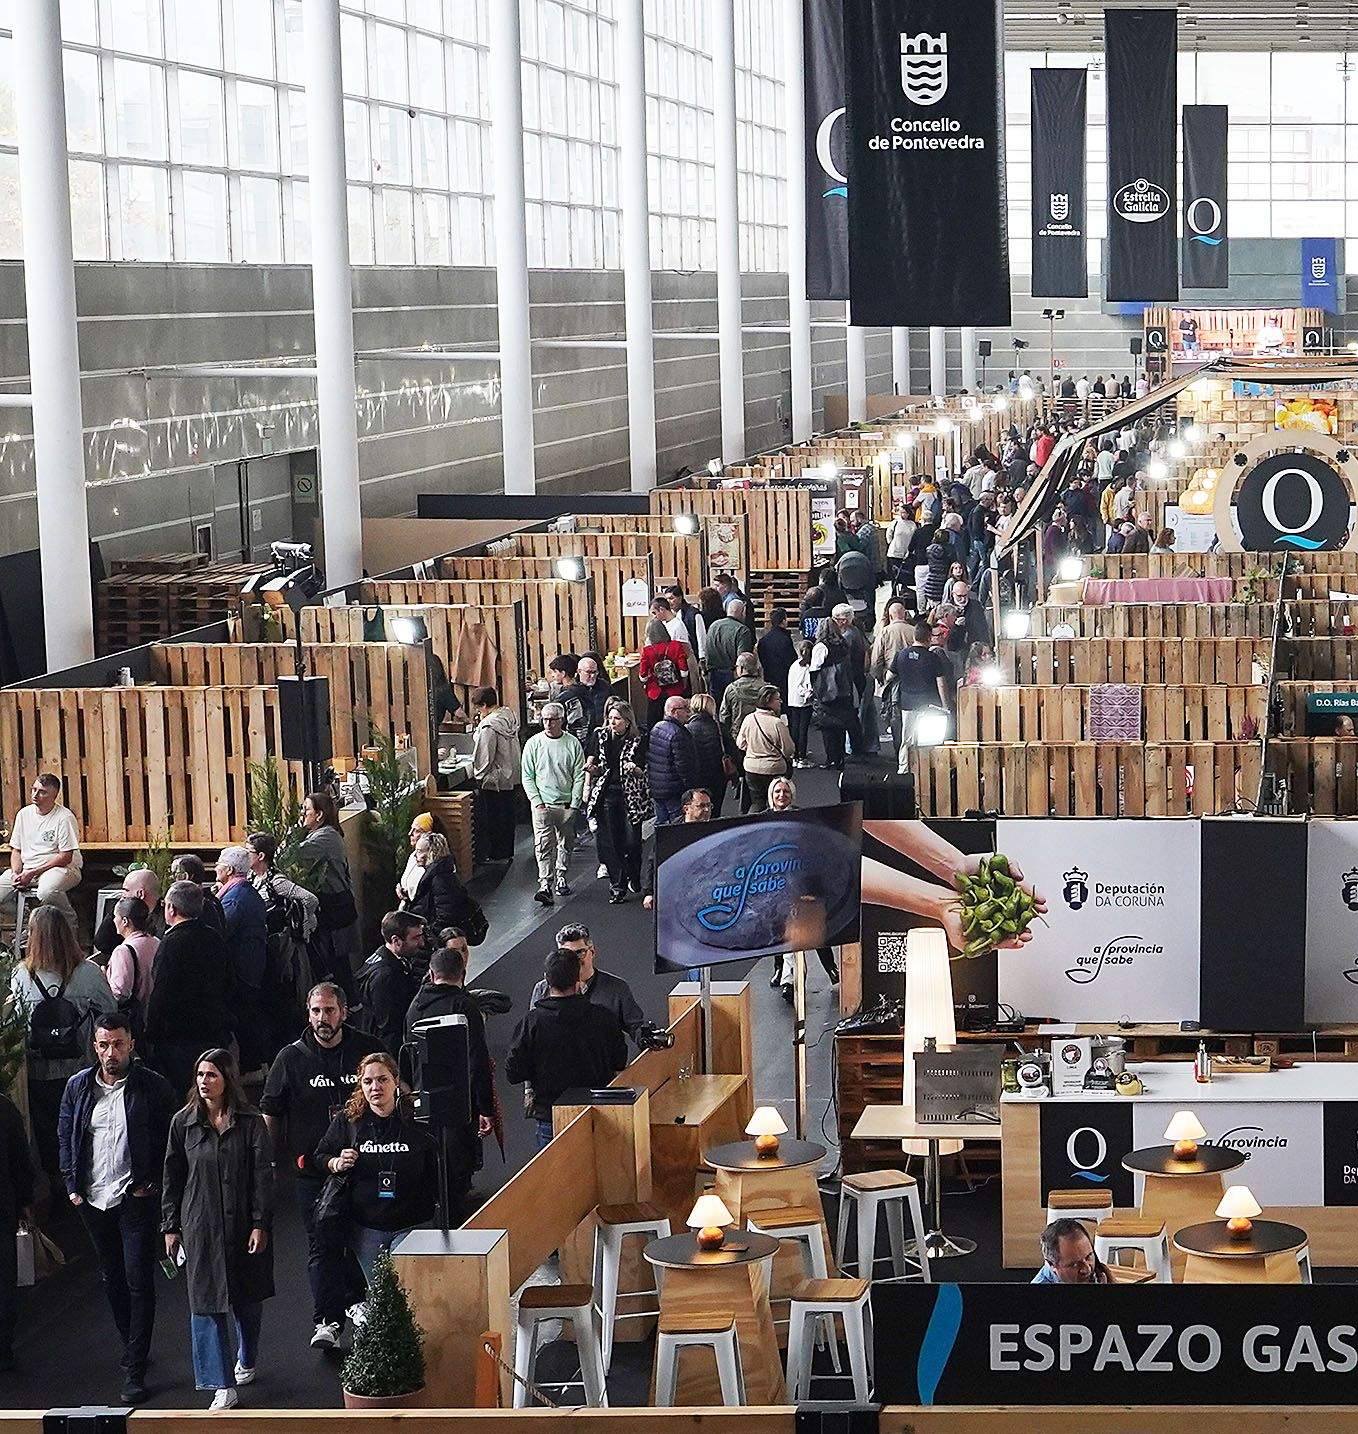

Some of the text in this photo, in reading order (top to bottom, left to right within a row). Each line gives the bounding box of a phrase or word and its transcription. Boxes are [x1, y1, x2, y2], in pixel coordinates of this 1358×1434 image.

[890, 117, 960, 132] Concello
[868, 135, 985, 151] de Pontevedra
[1122, 191, 1161, 202] Estrella
[1124, 201, 1160, 213] Galicia
[1186, 197, 1223, 246] Q
[1047, 229, 1081, 237] Pontevedra
[1261, 468, 1328, 550] Q
[1316, 699, 1333, 707] D.O.
[734, 858, 804, 880] a provin
[712, 877, 787, 902] que sabe
[1095, 883, 1165, 896] Deputación
[1095, 894, 1164, 907] DA CORUÑA
[1093, 943, 1164, 957] a provincia
[1076, 953, 1134, 968] que sabe
[1222, 1136, 1288, 1148] provincia
[1066, 1126, 1110, 1183] Q
[1343, 1175, 1357, 1184] DA
[989, 1323, 1222, 1373] ESPAZO
